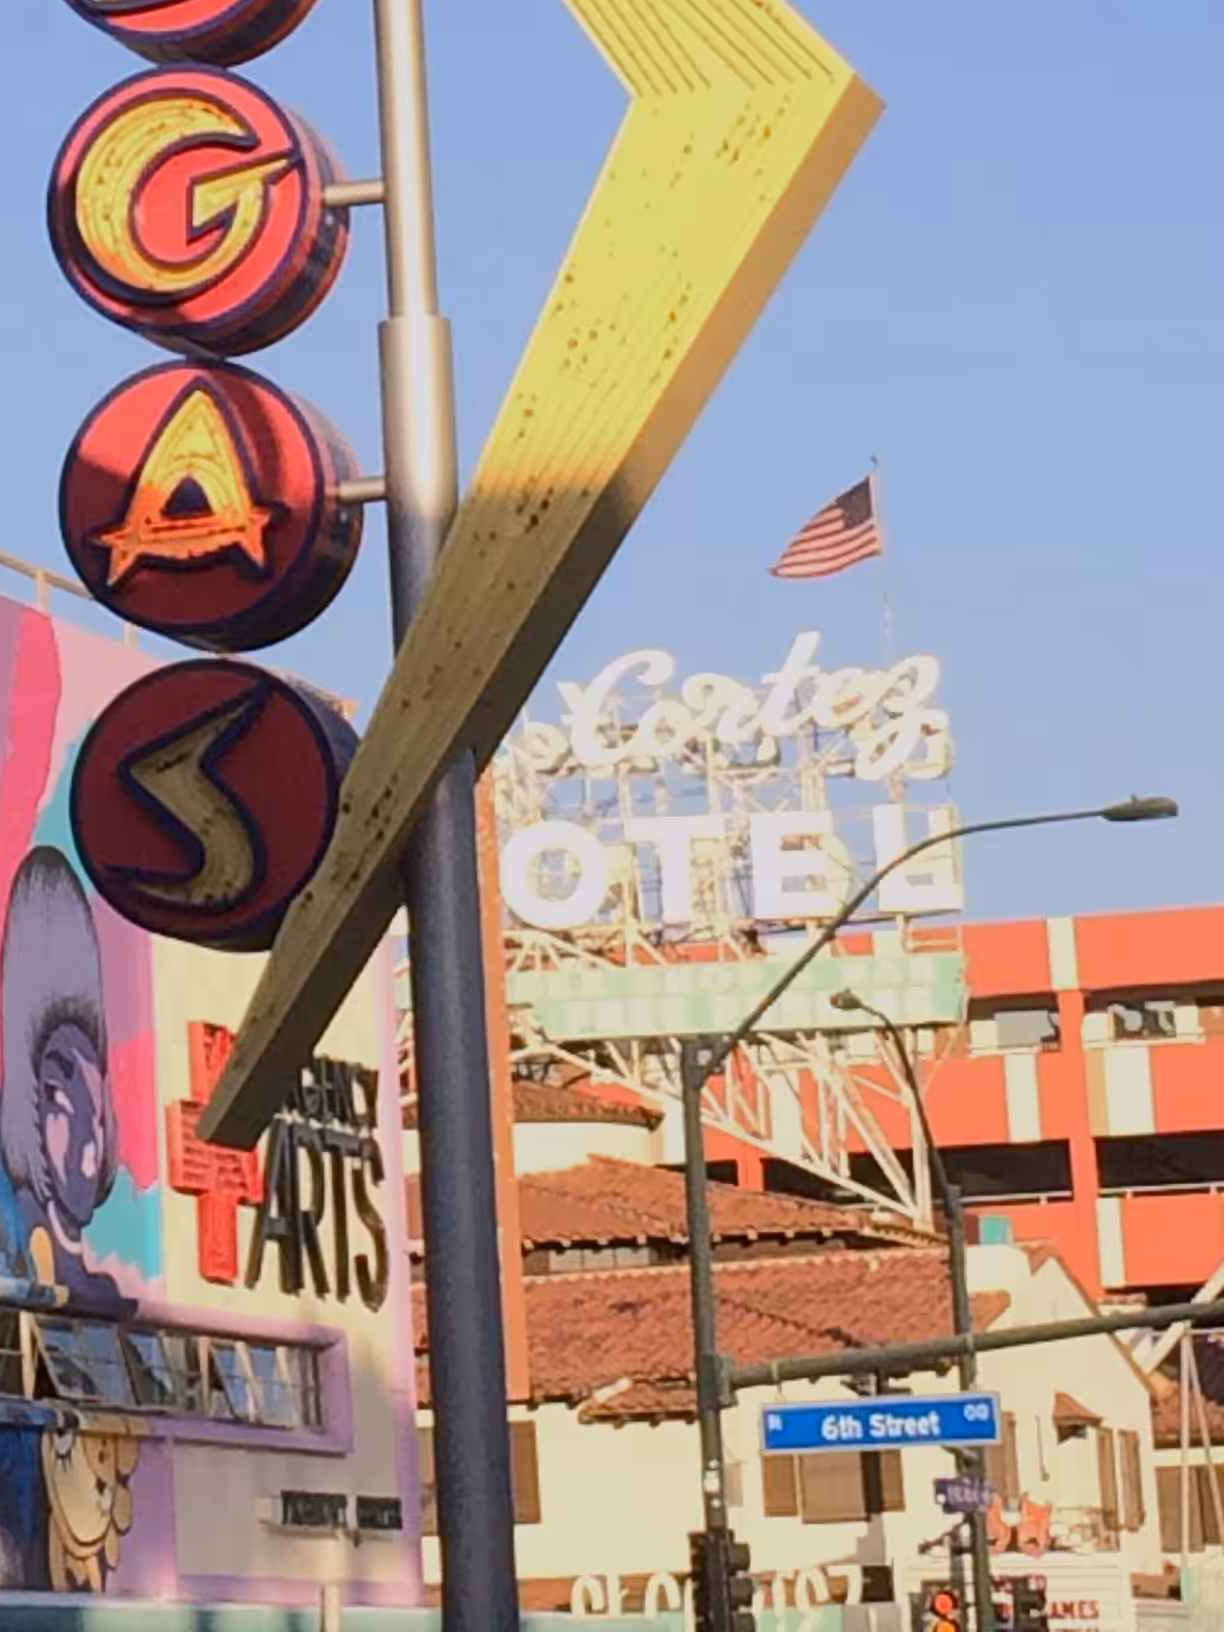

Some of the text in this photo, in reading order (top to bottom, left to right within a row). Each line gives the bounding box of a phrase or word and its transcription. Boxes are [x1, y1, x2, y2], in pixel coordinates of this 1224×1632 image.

[557, 631, 952, 781] Cortez
[498, 803, 963, 931] OTEL
[245, 1118, 389, 1313] ARTS
[821, 1414, 863, 1440] 6th
[869, 1410, 940, 1438] Street
[1048, 1600, 1099, 1619] AMES
